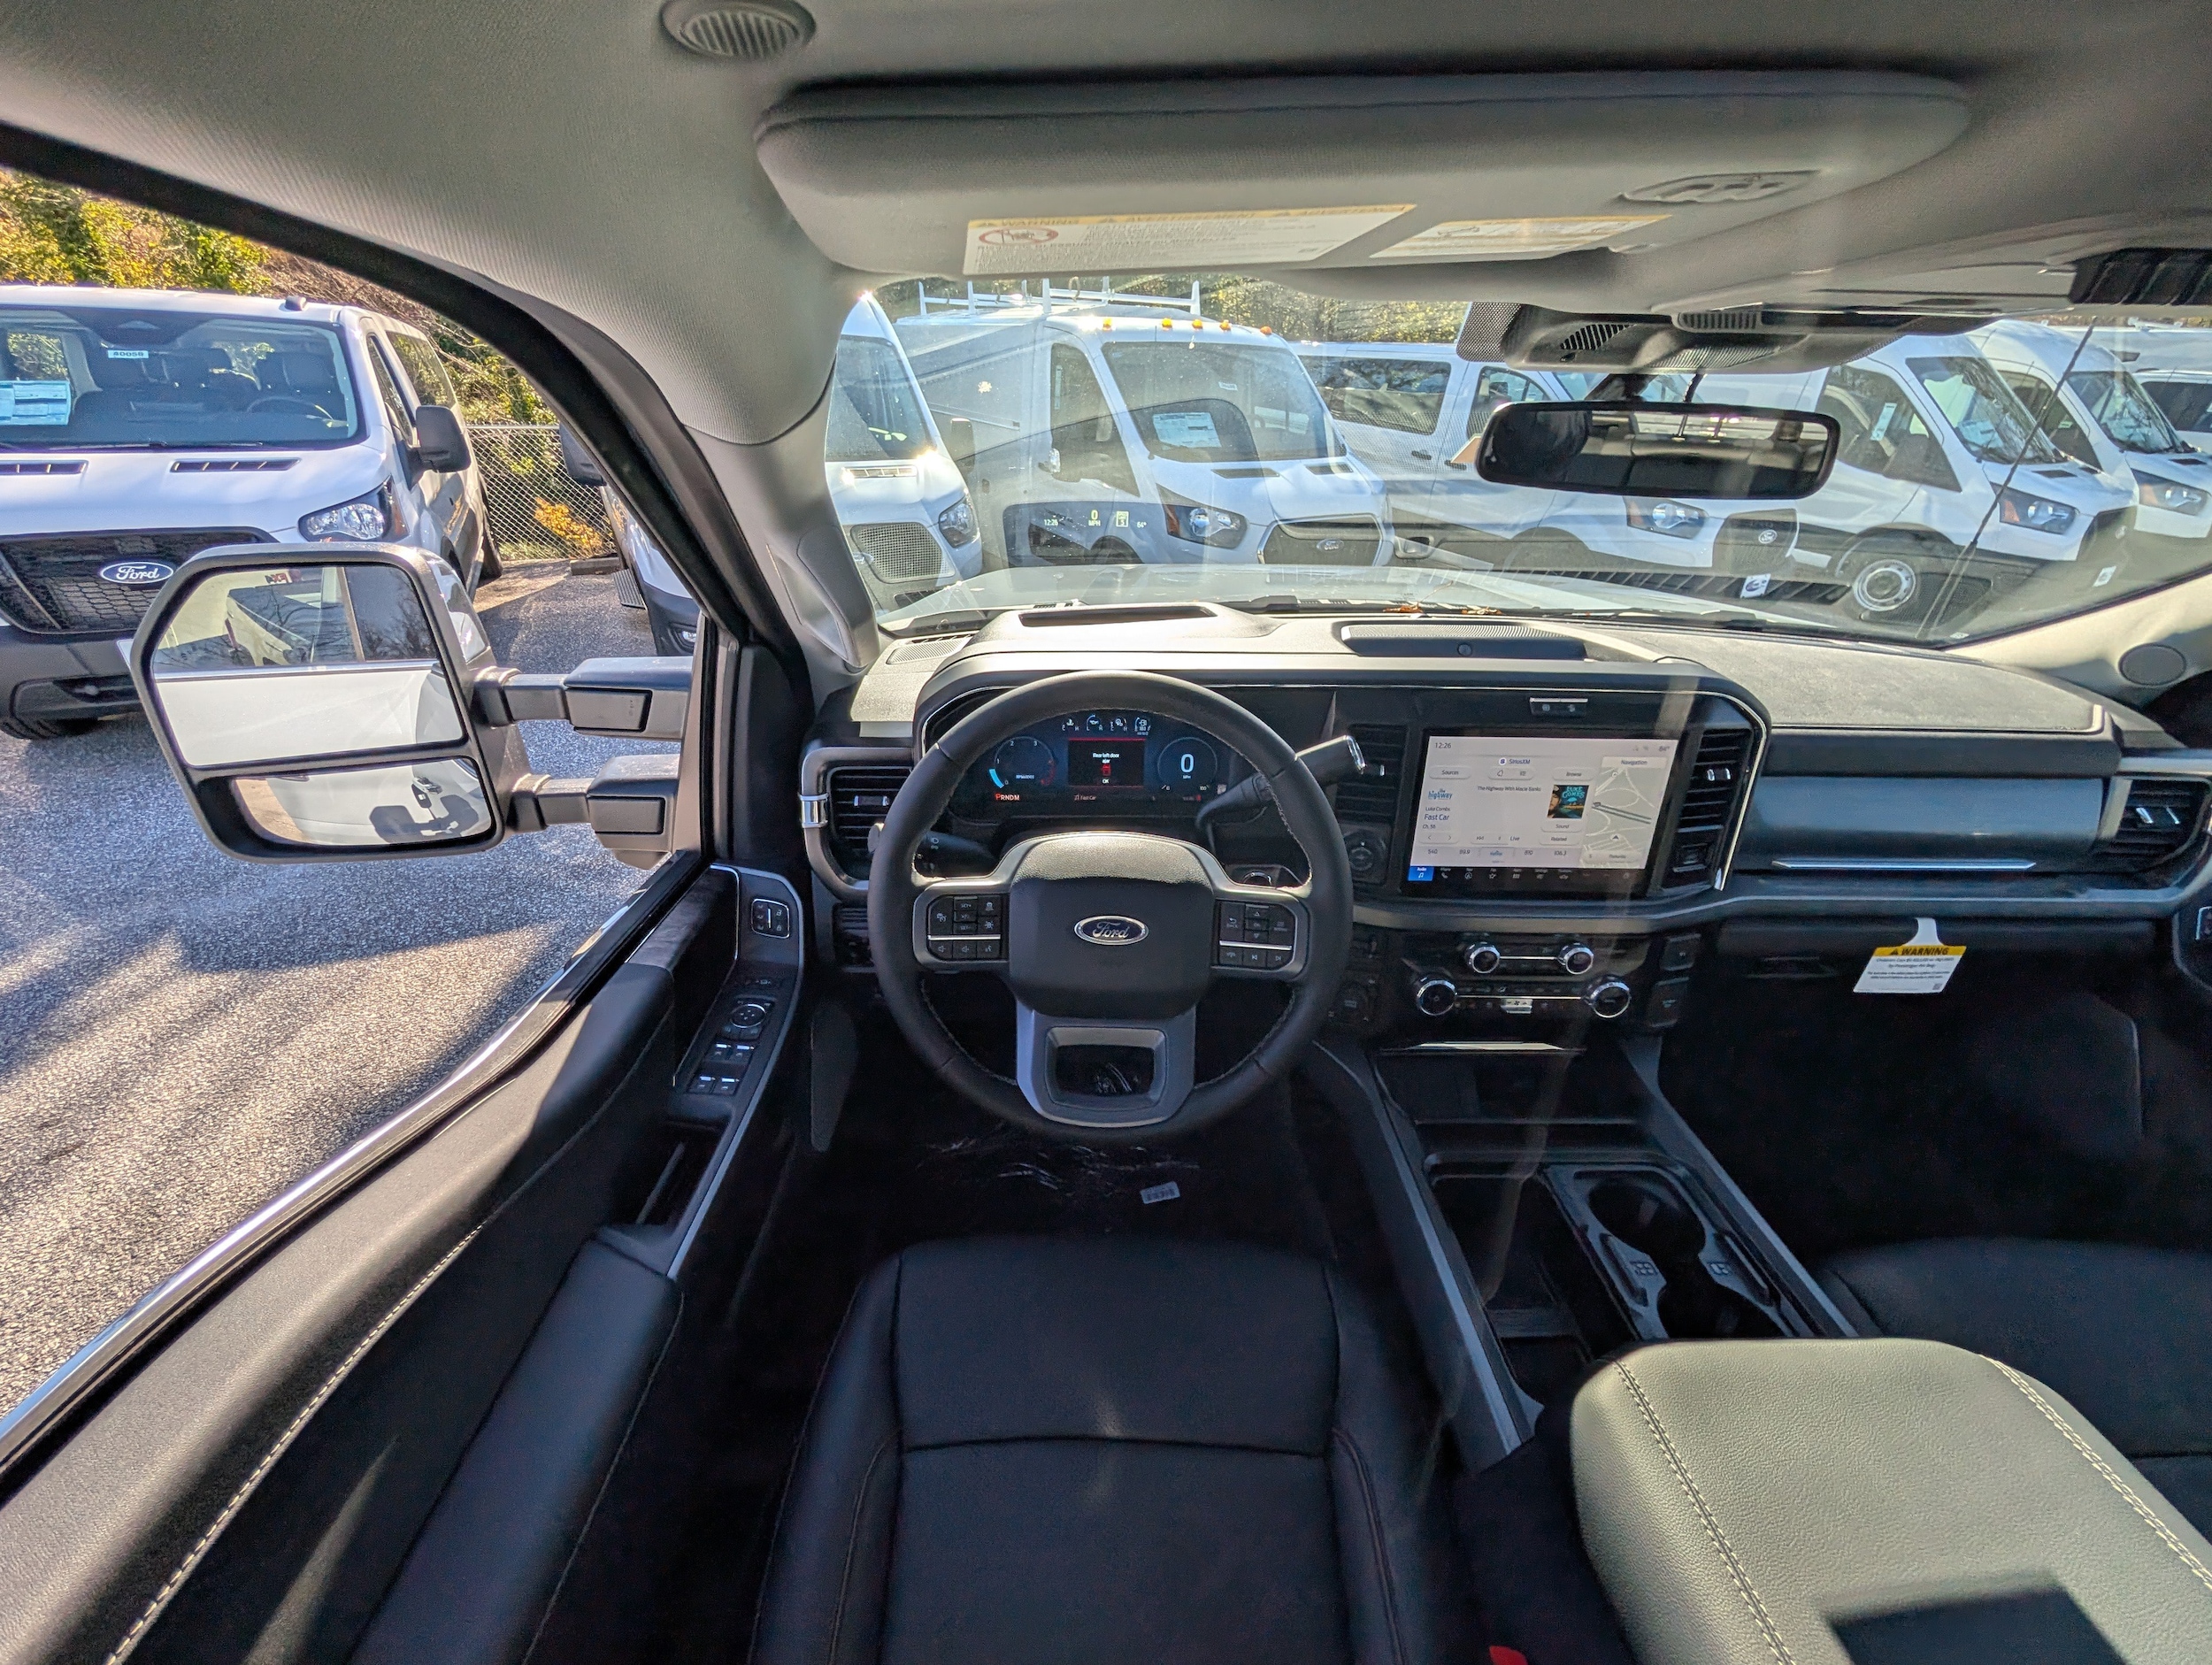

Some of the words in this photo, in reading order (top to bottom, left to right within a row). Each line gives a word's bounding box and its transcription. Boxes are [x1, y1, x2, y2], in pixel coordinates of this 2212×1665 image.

[1091, 510, 1098, 520] 0
[116, 565, 160, 580] Ford
[1180, 753, 1194, 773] 0
[1092, 921, 1130, 938] Ford
